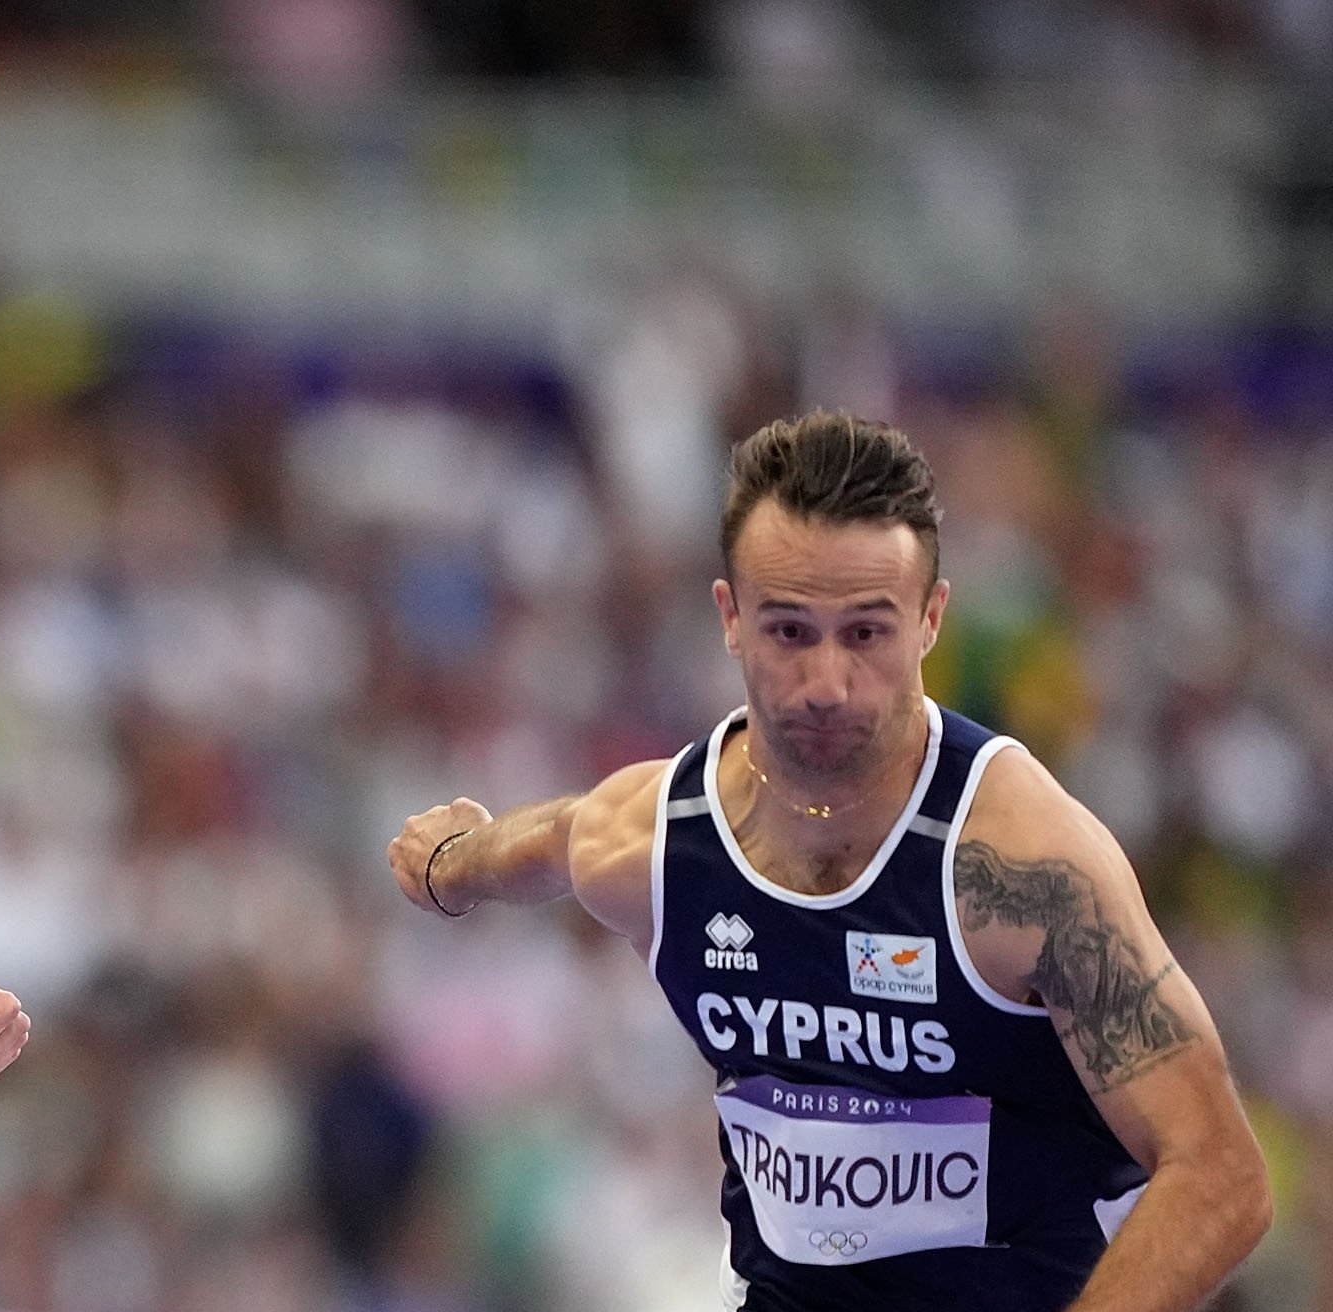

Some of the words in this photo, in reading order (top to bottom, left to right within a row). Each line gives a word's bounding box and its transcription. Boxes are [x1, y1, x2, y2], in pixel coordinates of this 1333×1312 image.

[696, 992, 956, 1073] CYPRUS
[773, 1087, 839, 1113] PARIS
[848, 1097, 911, 1115] 2024
[731, 1122, 980, 1208] TRAJKOVIC
